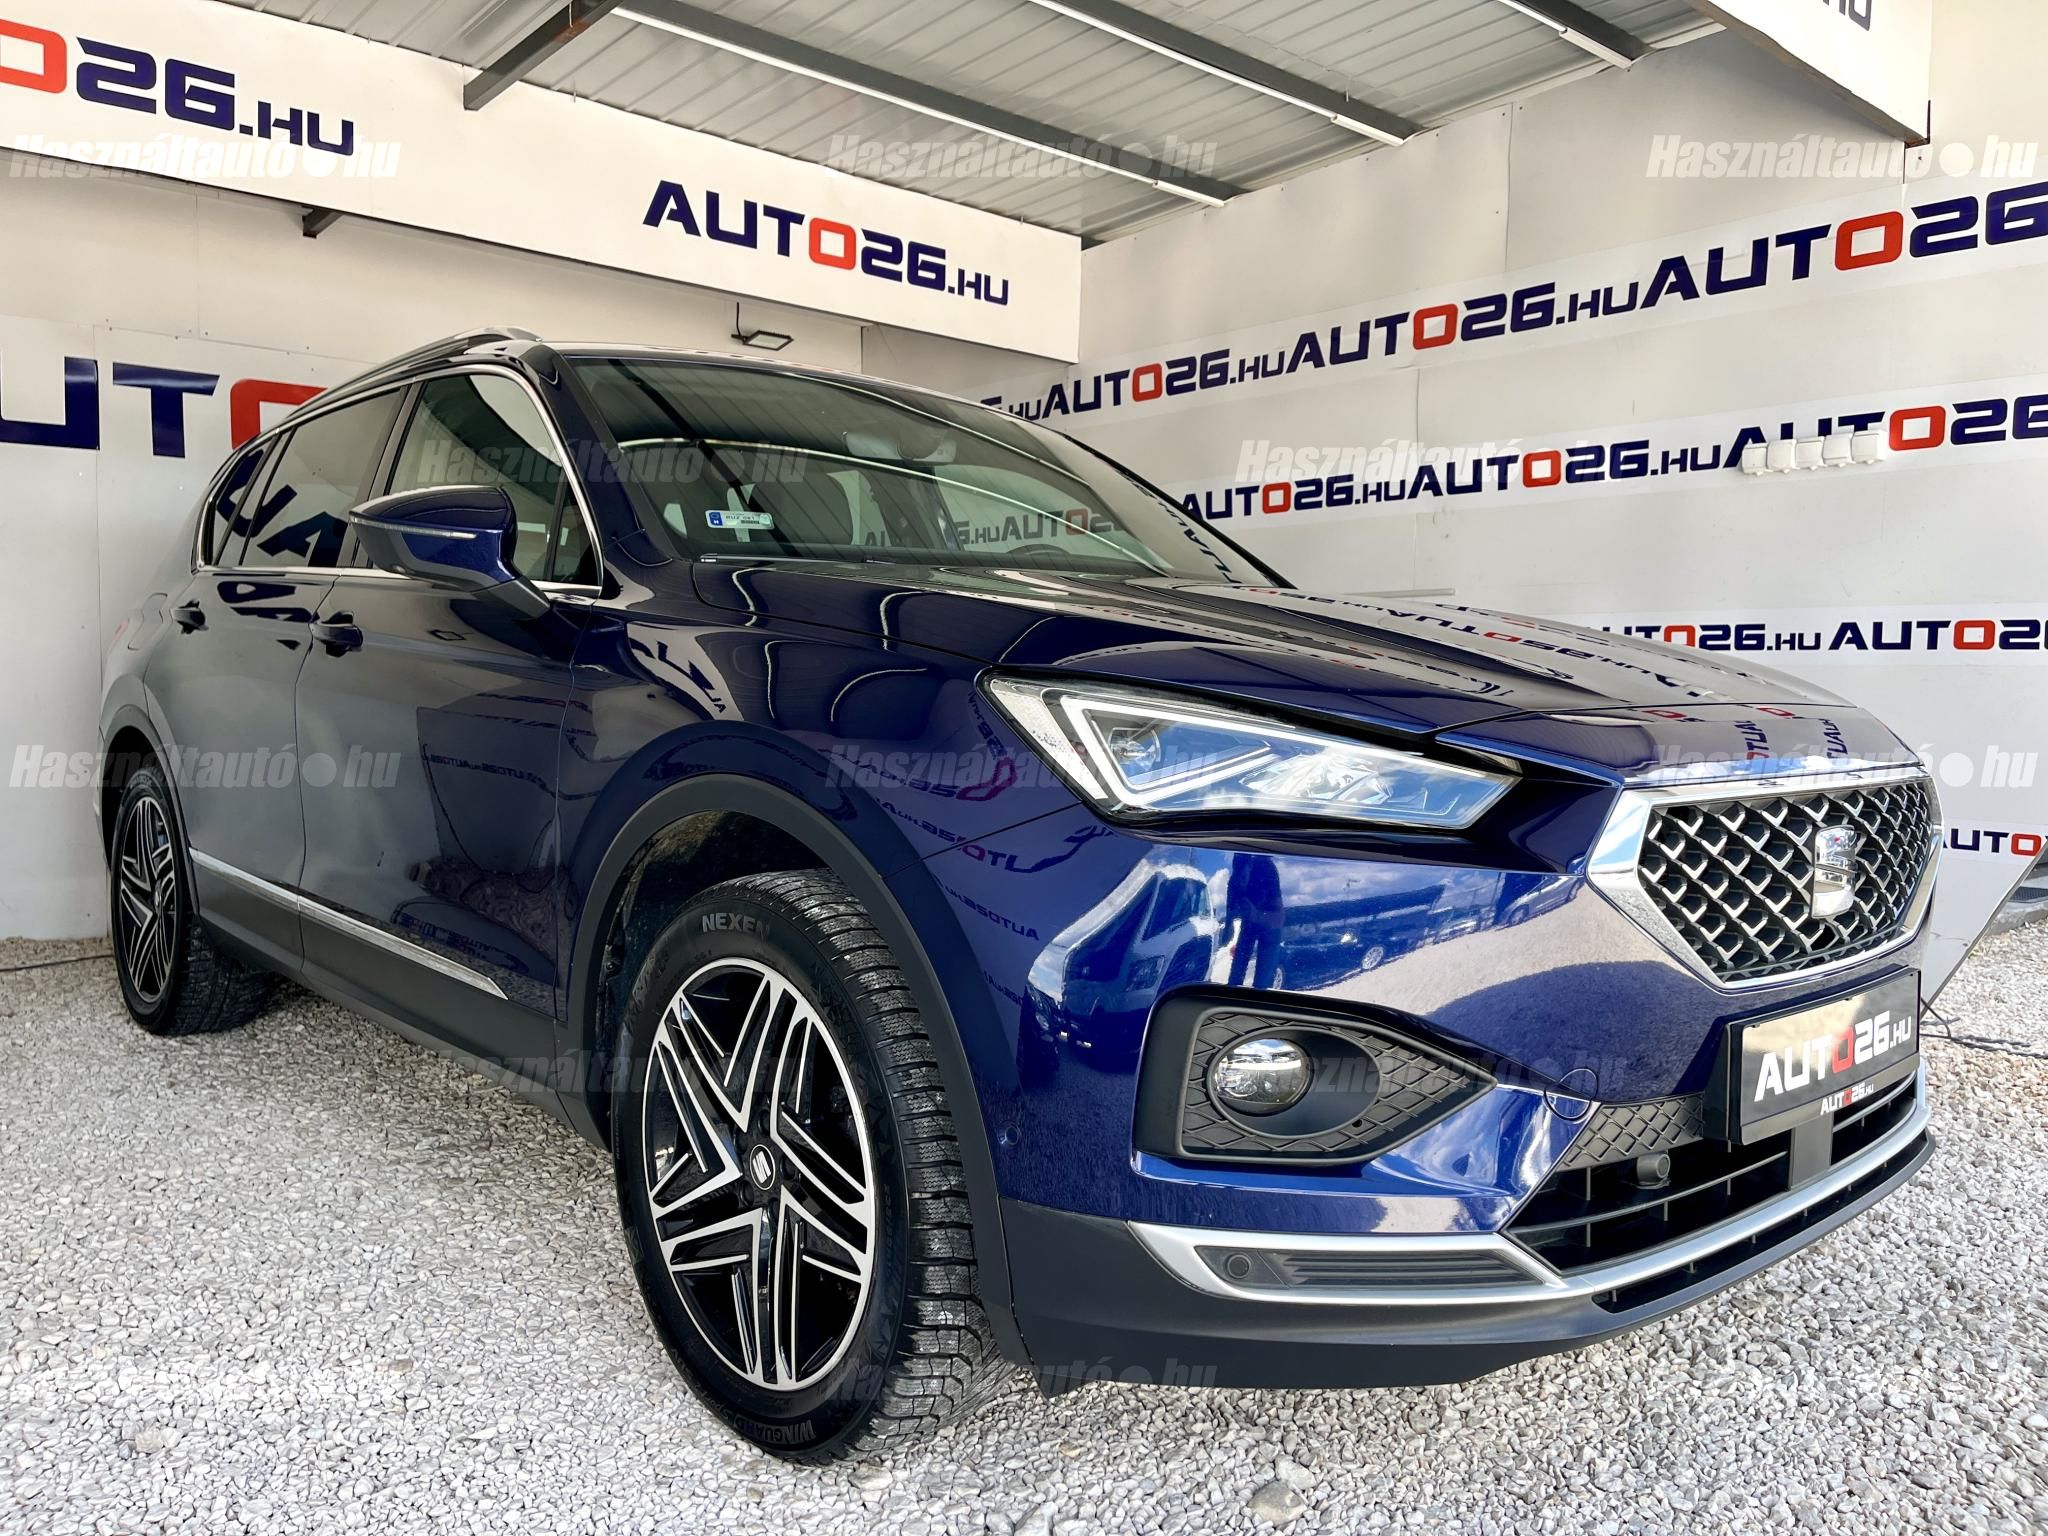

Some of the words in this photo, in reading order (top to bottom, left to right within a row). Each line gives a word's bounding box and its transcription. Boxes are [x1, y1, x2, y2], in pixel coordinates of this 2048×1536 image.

[643, 180, 1009, 306] AUTO26.HU
[1829, 619, 2048, 650] AUTO2
[702, 912, 770, 942] NEXEN
[1754, 1010, 1912, 1103] AUTO26.HU
[1820, 1082, 1874, 1116] AUTO26.HU
